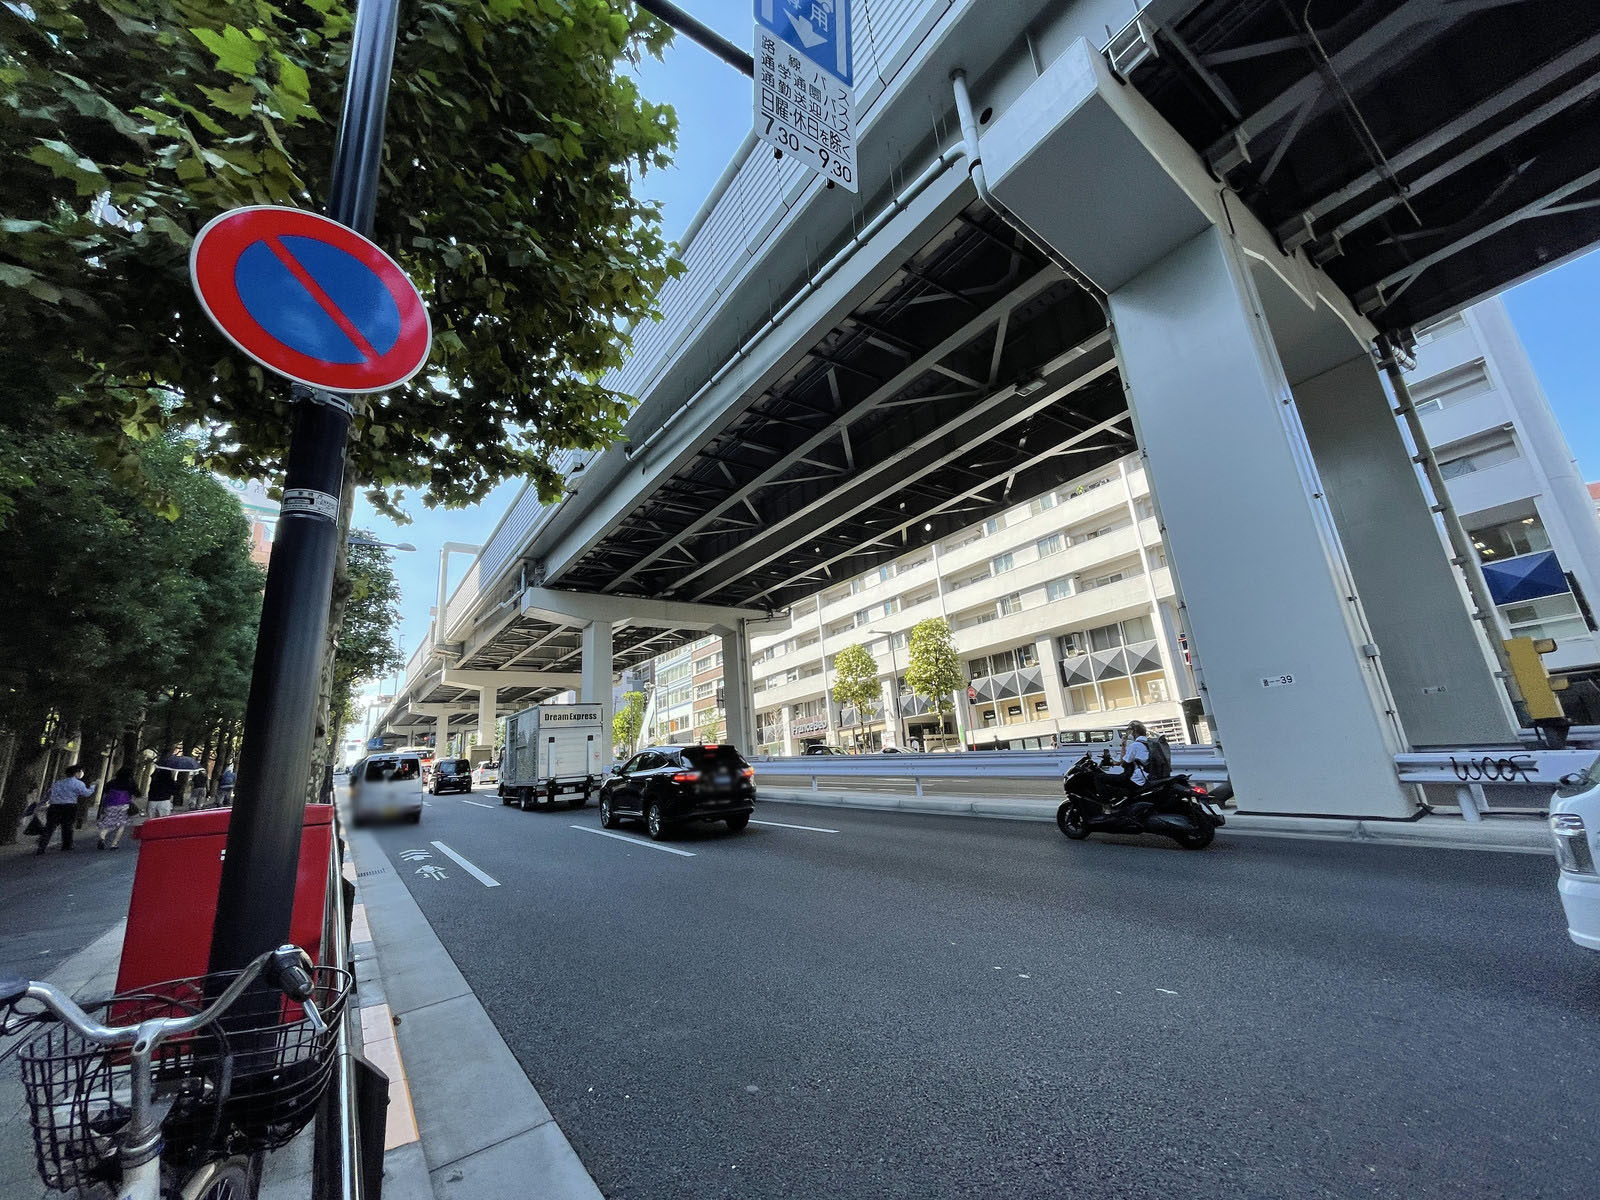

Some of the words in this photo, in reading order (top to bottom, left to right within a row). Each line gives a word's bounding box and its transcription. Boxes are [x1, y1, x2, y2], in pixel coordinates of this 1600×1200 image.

[762, 35, 850, 106] 路線バス
[762, 51, 850, 121] 通学通園バス
[762, 68, 851, 138] 通勤送迎バス
[544, 713, 569, 721] Dream
[570, 712, 597, 721] Express
